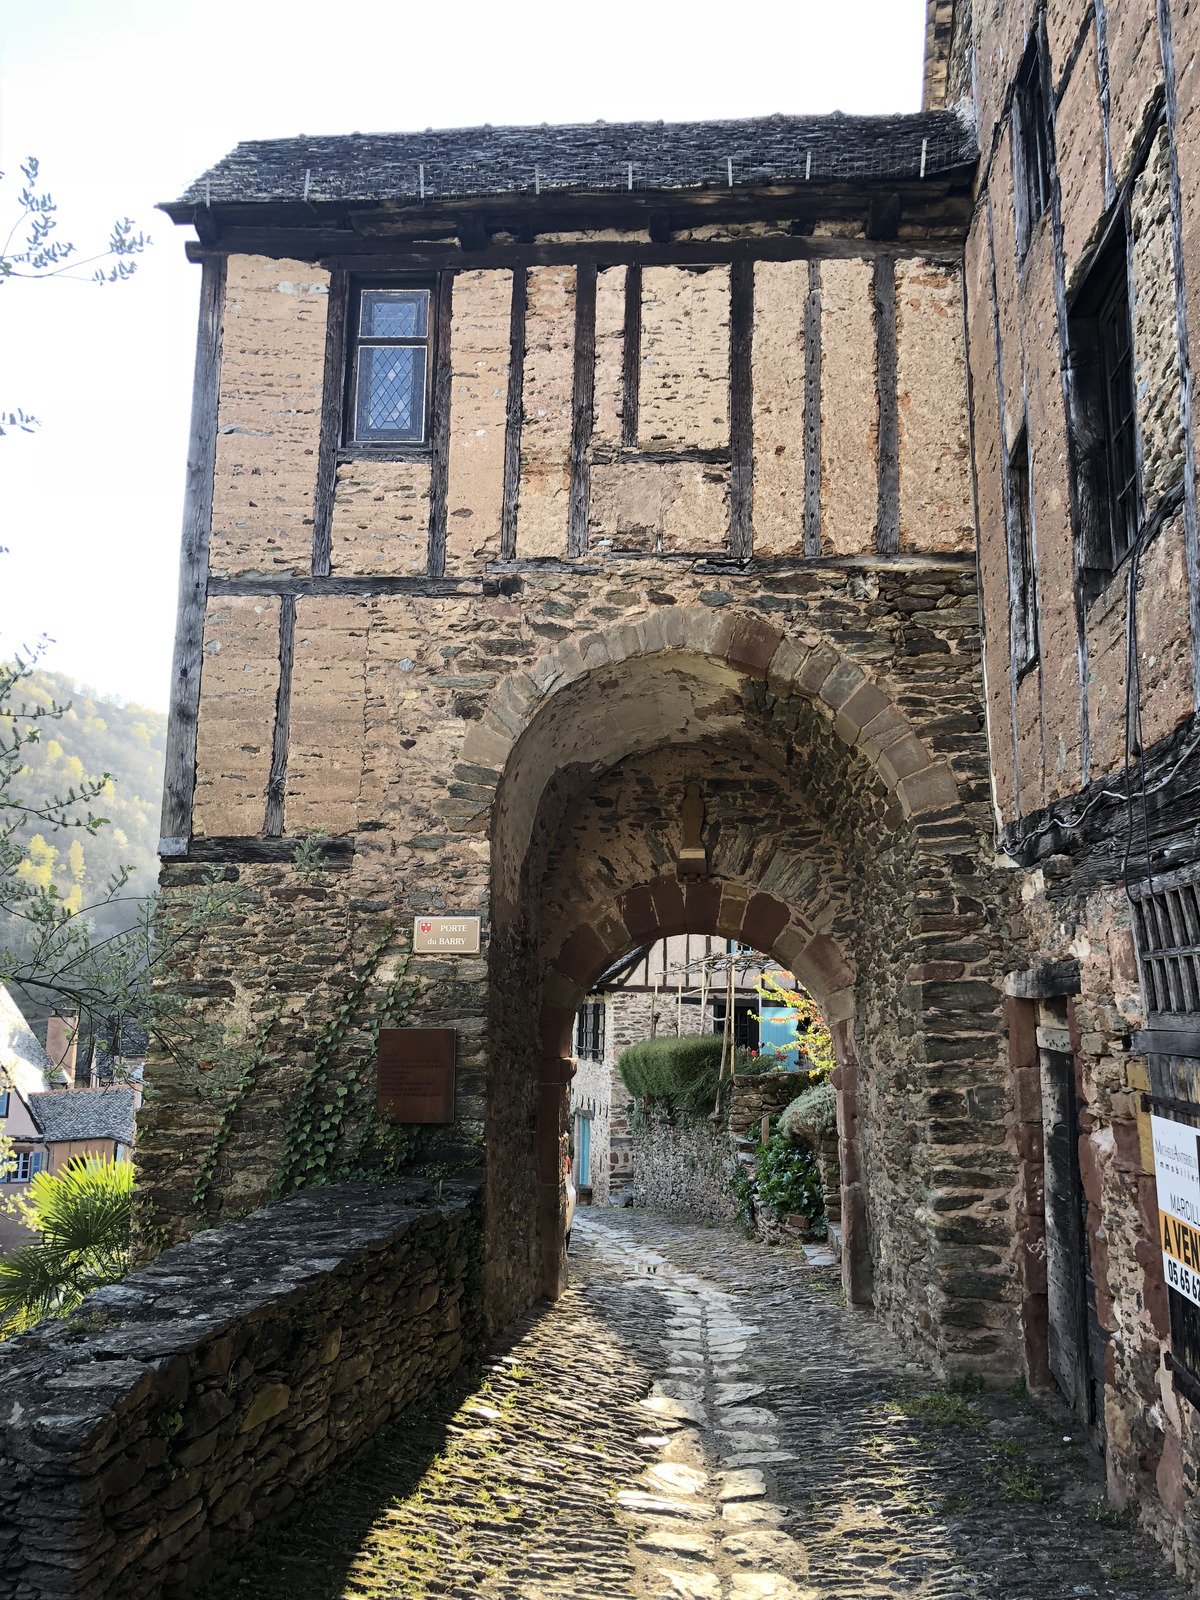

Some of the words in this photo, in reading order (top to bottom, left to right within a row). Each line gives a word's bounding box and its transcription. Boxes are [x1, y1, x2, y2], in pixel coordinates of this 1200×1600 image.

[427, 937, 437, 945] du
[439, 937, 467, 945] BARRY
[440, 924, 468, 932] PORTE
[1170, 1193, 1200, 1227] MARCILL
[1164, 1215, 1173, 1254] A
[1172, 1220, 1200, 1273] VEN
[1168, 1259, 1178, 1286] 05
[1180, 1267, 1190, 1294] 65
